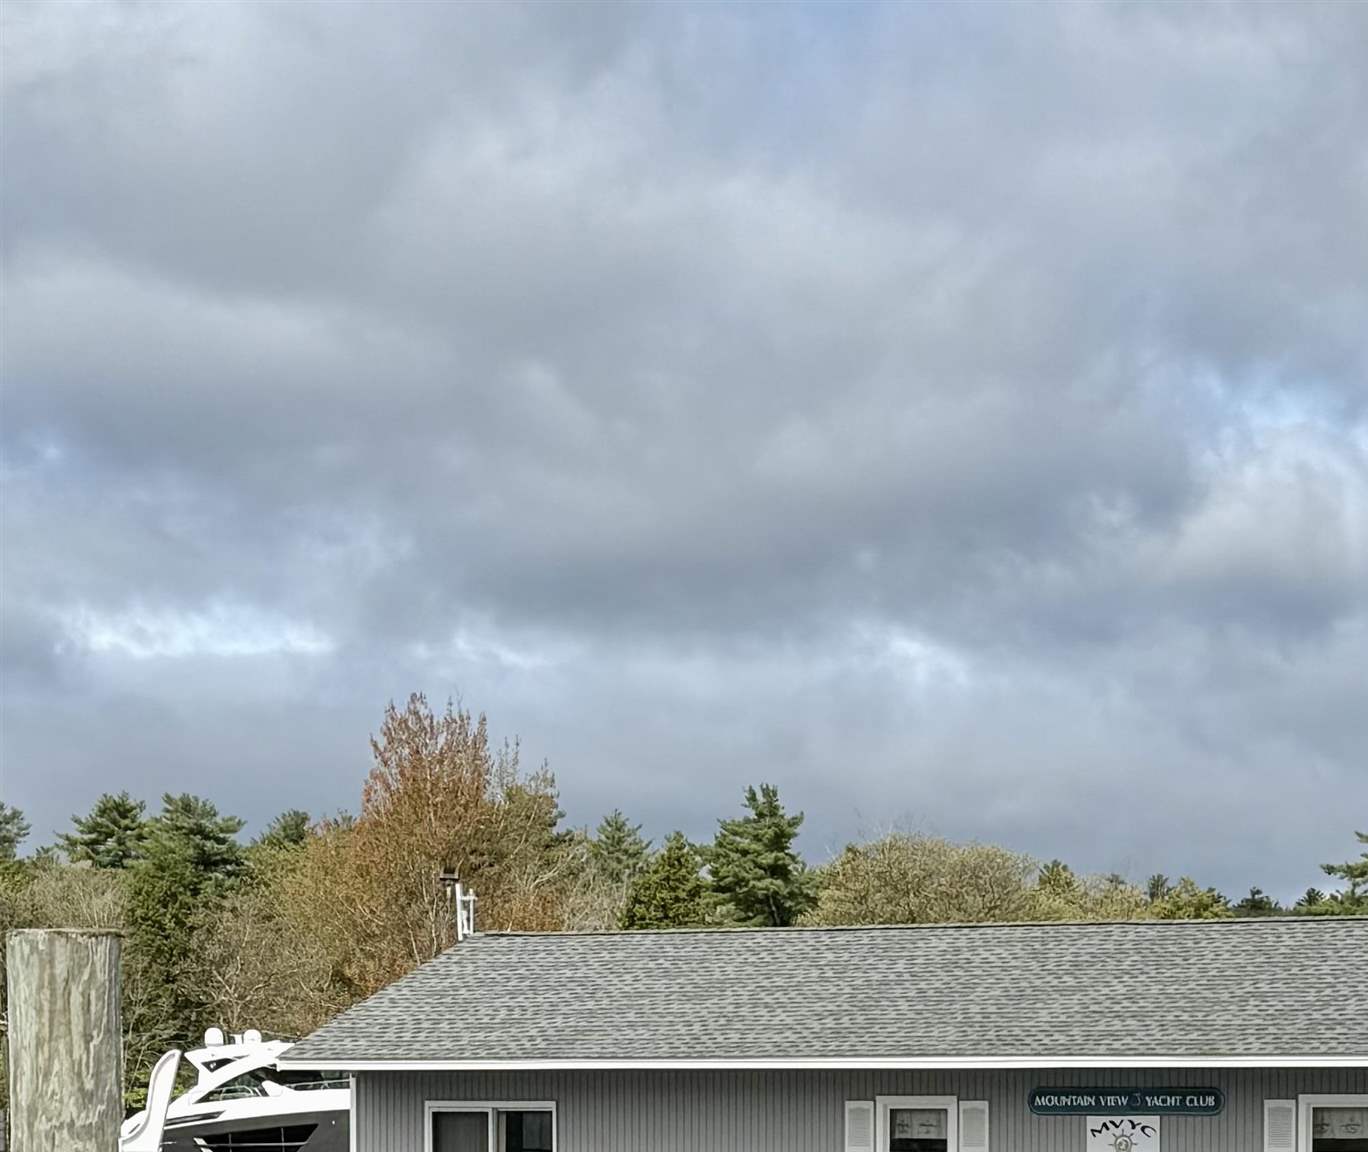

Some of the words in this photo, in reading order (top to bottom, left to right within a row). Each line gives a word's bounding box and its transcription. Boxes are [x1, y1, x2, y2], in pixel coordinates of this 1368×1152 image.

[1034, 1095, 1096, 1107] MOUNTAIN
[1099, 1095, 1129, 1107] VIEW
[1145, 1095, 1182, 1107] YACHT
[1186, 1095, 1216, 1107] CLUB
[1090, 1119, 1157, 1138] MVYC
